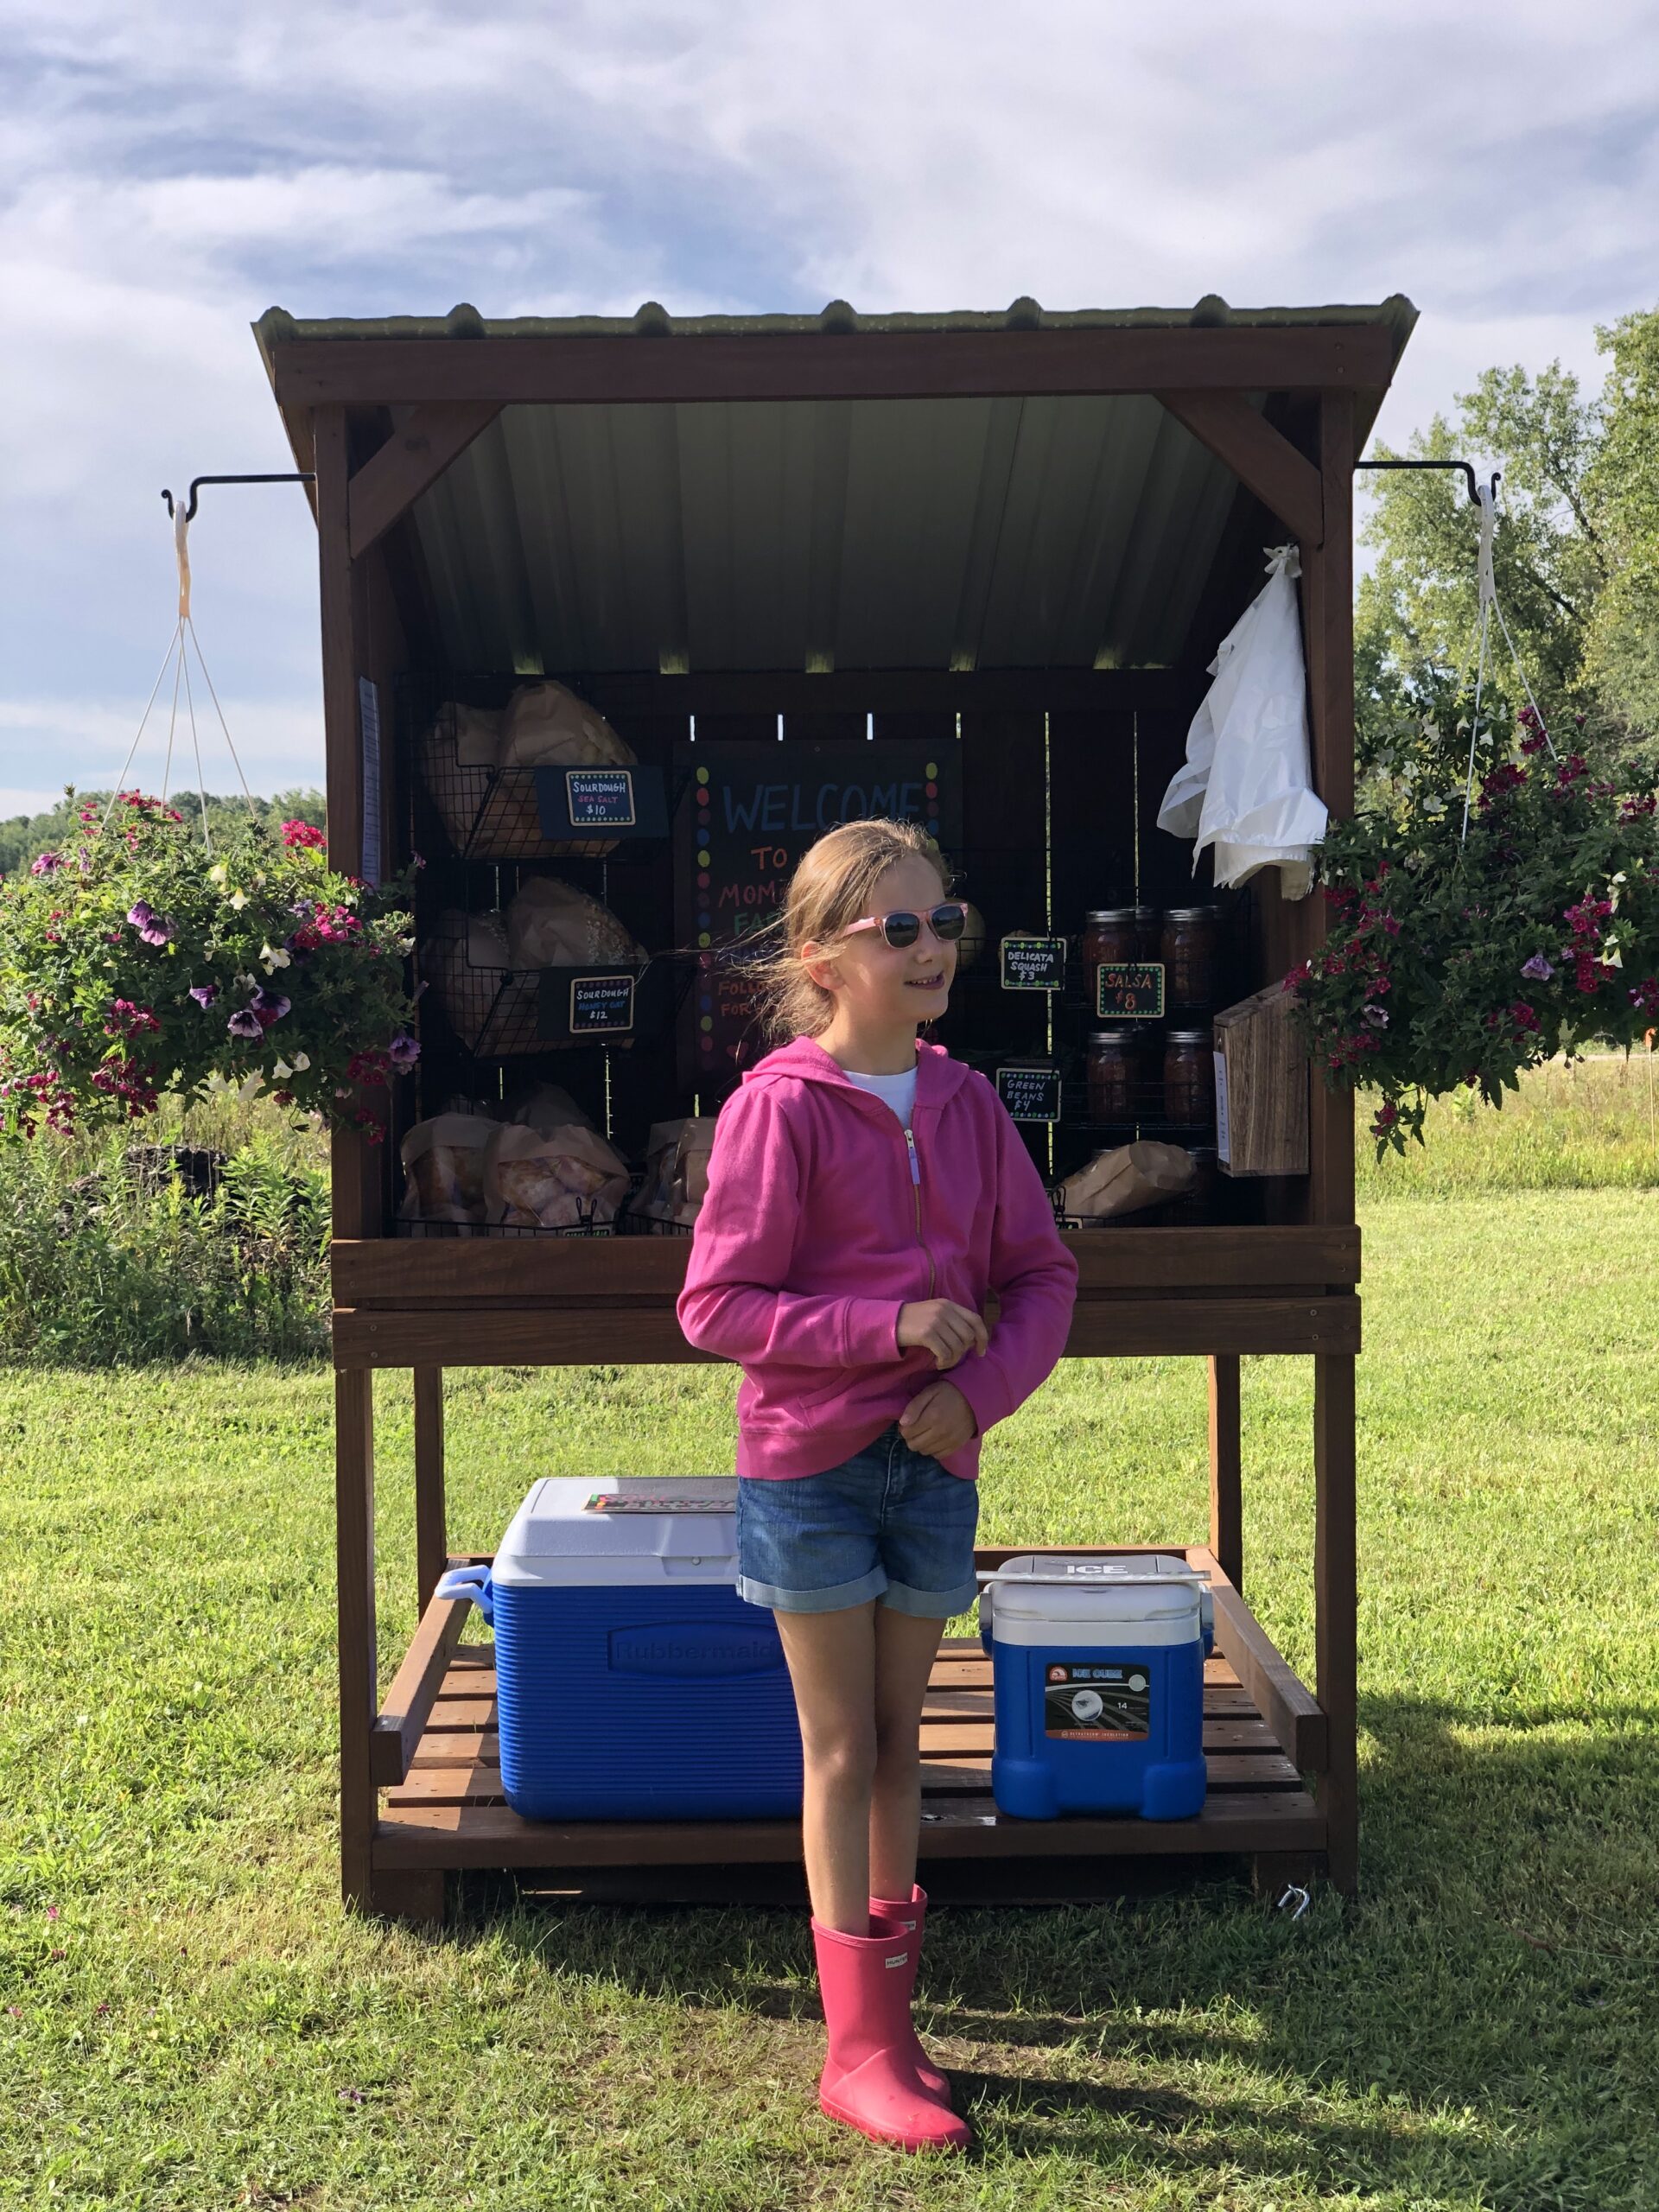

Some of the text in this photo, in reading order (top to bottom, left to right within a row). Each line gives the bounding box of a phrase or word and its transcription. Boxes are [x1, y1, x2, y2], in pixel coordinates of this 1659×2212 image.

[573, 781, 626, 793] SOURDOUGH
[597, 795, 619, 804] SALT
[586, 804, 606, 816] $10
[723, 783, 923, 834] WELCOME
[750, 847, 787, 870] TO
[1007, 951, 1054, 963] DELICATA
[1010, 961, 1048, 973] SQUASH
[1019, 970, 1035, 981] $3
[1105, 973, 1152, 989] SALSA
[576, 988, 629, 1000] SOURDOUGH
[1115, 989, 1136, 1011] $8
[589, 1010, 608, 1020] $12
[1007, 1080, 1046, 1091] GREEN
[1007, 1091, 1045, 1102] BEANS
[1014, 1100, 1031, 1111] $4
[1067, 1565, 1128, 1574] ICE
[614, 1640, 777, 1660] Rubbermaid
[1071, 1668, 1091, 1679] ICE
